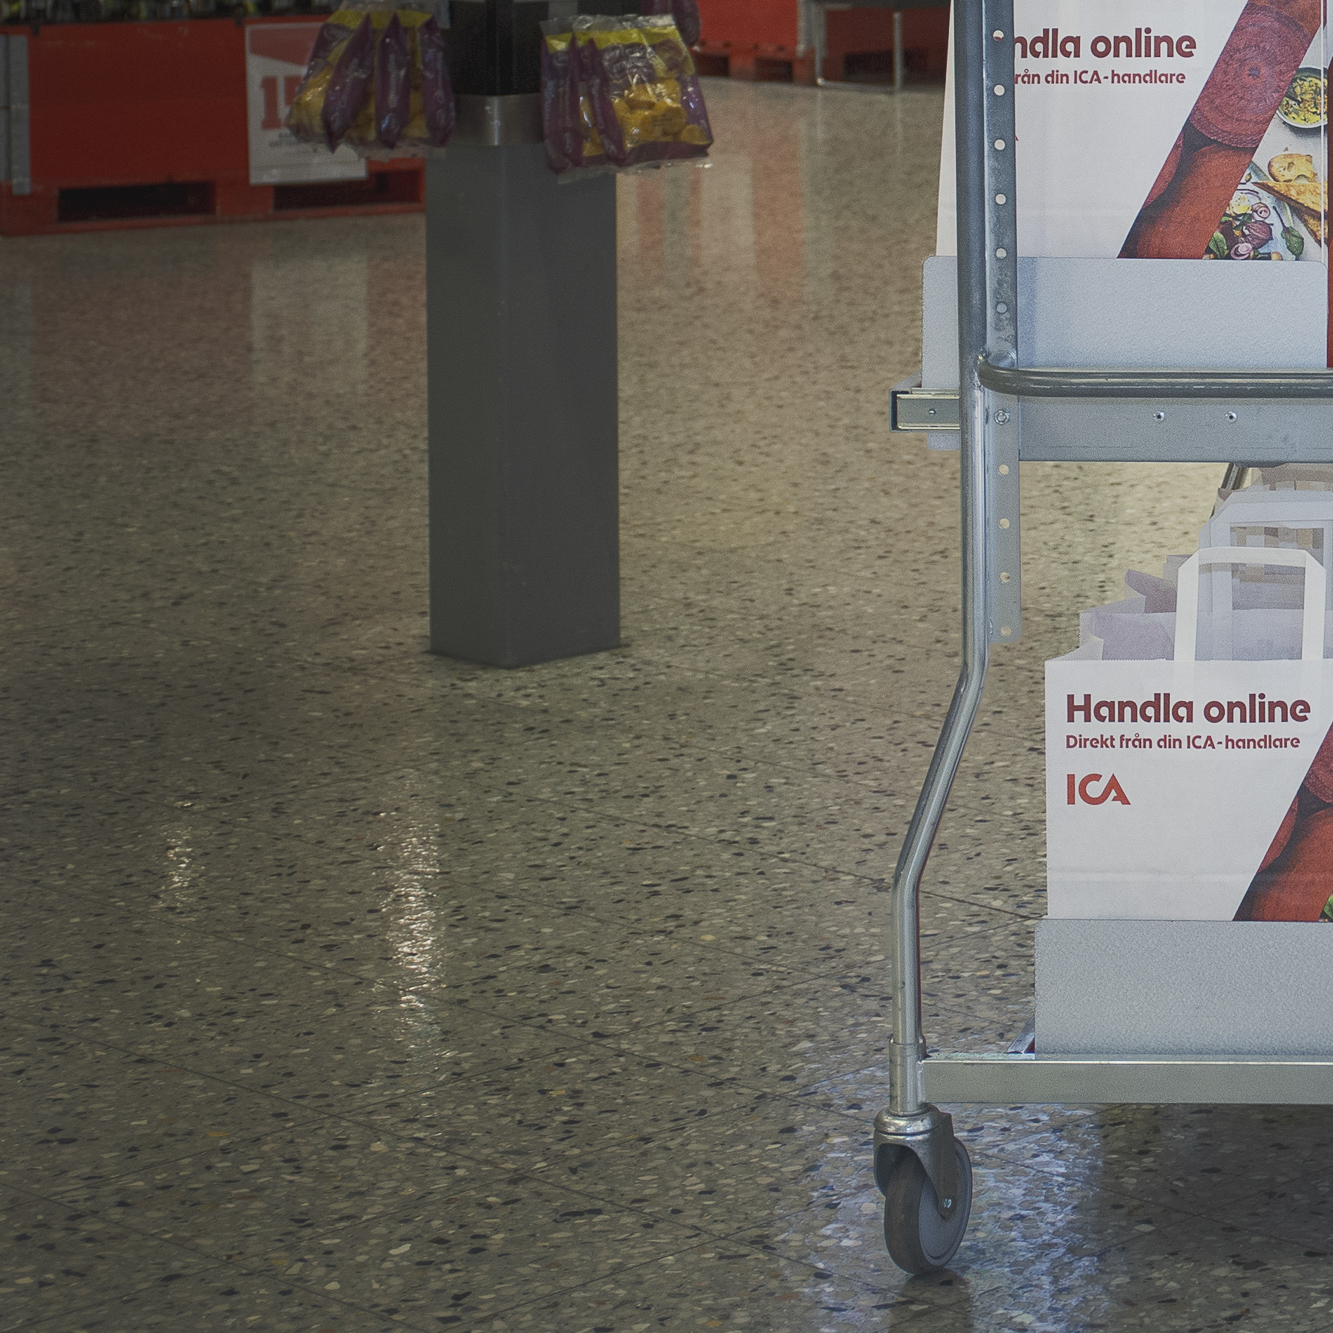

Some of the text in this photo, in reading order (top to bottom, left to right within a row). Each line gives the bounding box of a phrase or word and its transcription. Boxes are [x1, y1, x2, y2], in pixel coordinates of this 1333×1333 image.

[1090, 27, 1197, 59] online
[1044, 69, 1070, 85] din
[1073, 69, 1186, 85] ICA-handlare
[1066, 692, 1312, 723] Handla online
[1066, 732, 1301, 749] Direkt från din ICA-handlare
[1066, 773, 1131, 806] ICA
